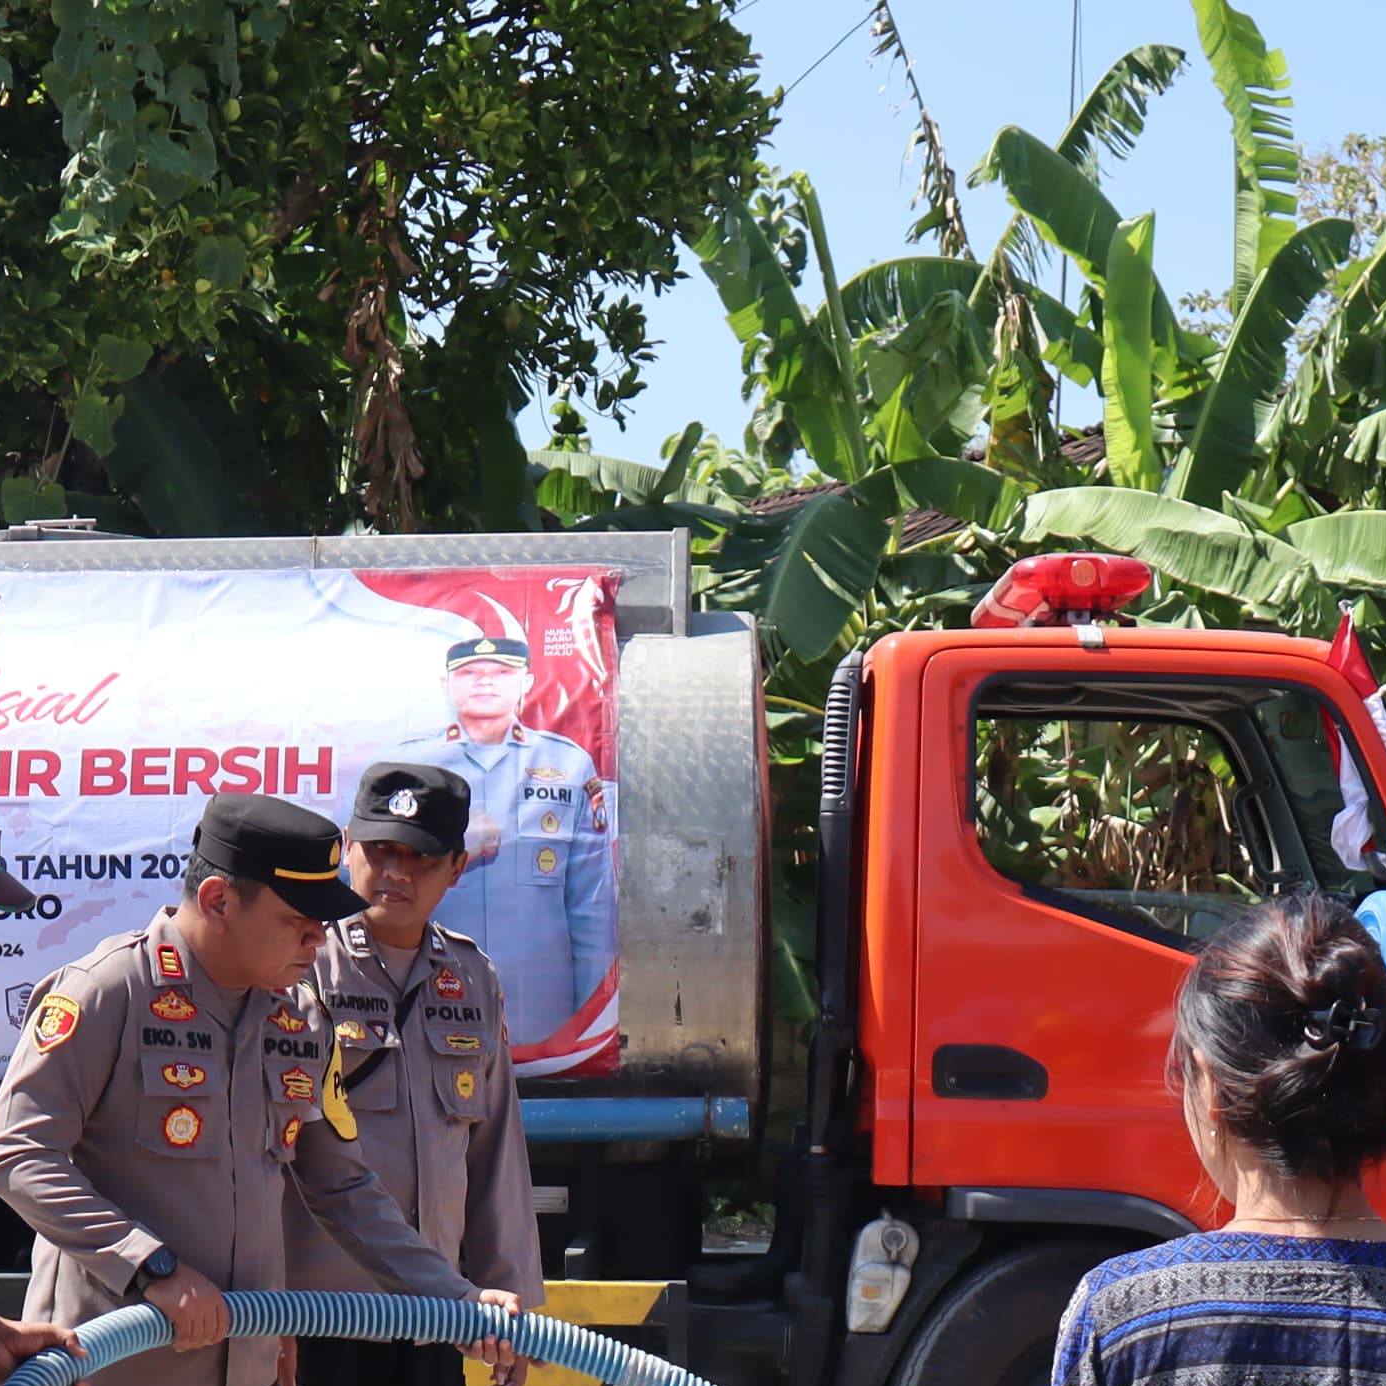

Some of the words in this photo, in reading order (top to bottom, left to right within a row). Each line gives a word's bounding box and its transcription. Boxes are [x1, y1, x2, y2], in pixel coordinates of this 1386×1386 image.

[79, 746, 333, 796] BERSIH
[524, 787, 572, 804] POLRI
[15, 854, 132, 880] TAHUN
[424, 1006, 481, 1022] POLRI
[142, 1027, 181, 1046] EKO.
[187, 1031, 212, 1050] SW
[264, 1037, 319, 1060] POLRI
